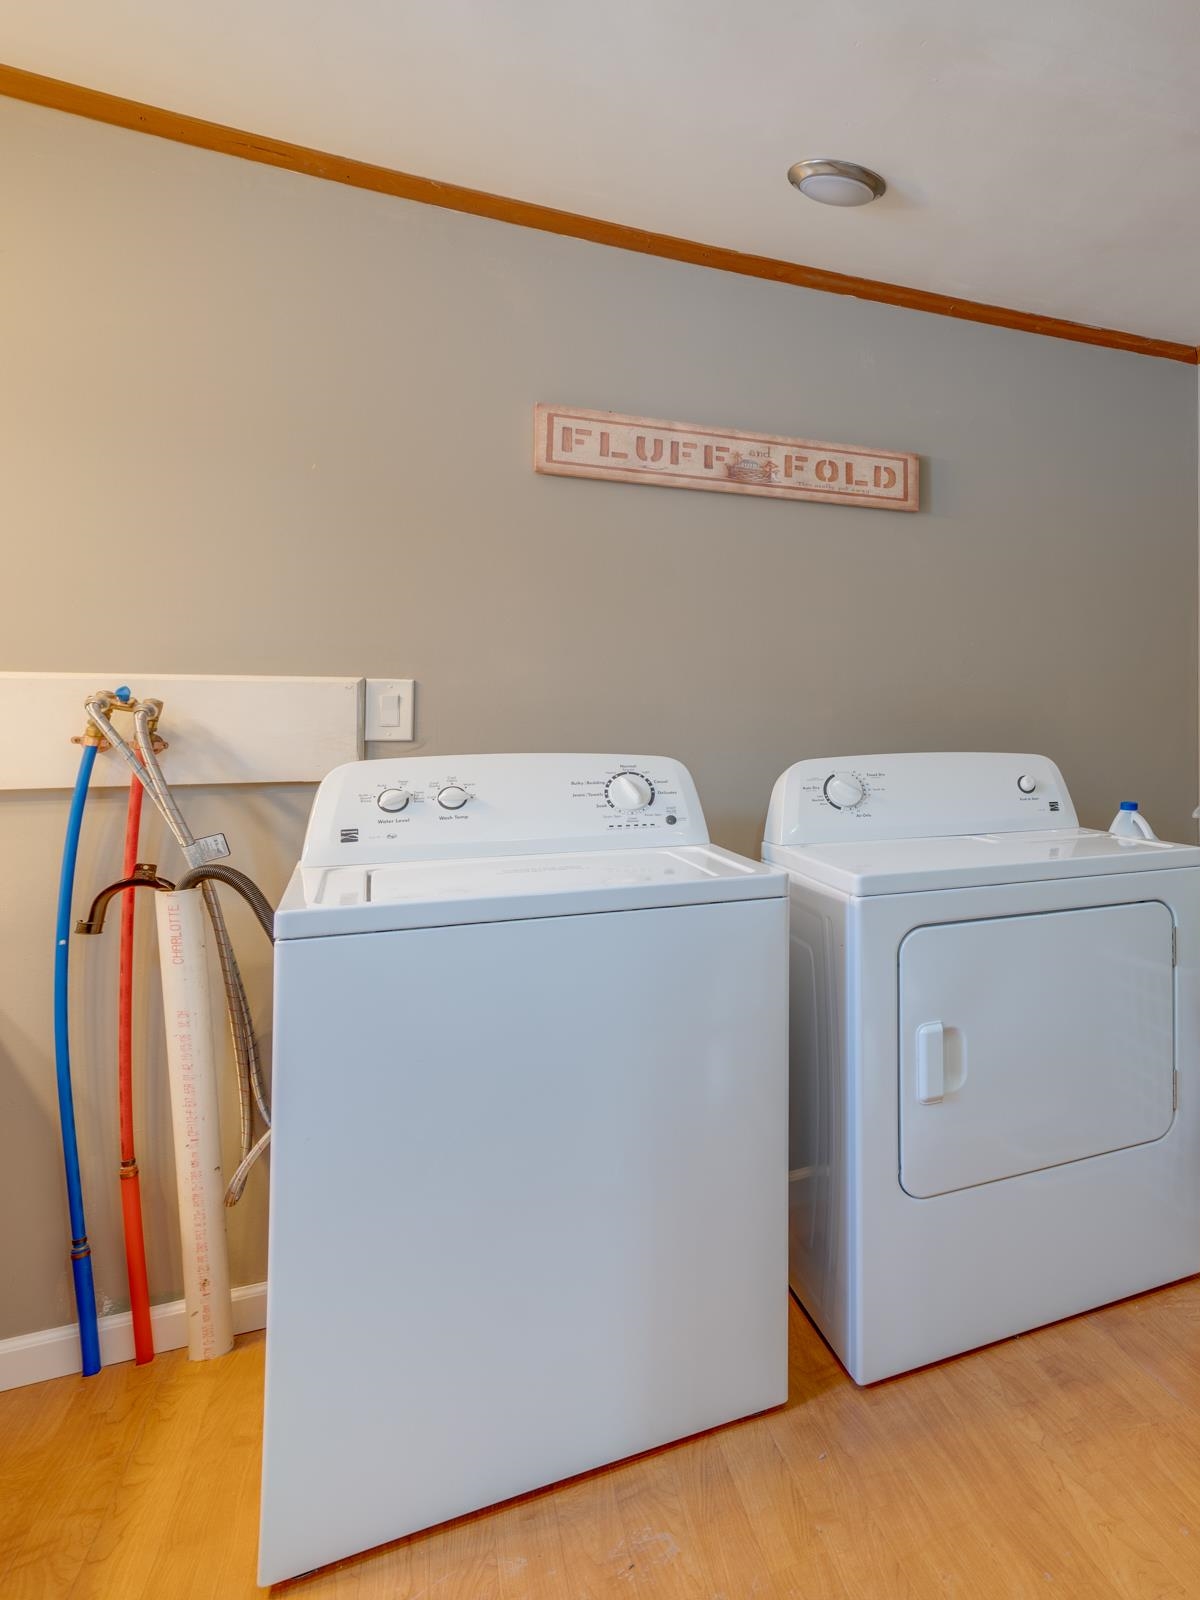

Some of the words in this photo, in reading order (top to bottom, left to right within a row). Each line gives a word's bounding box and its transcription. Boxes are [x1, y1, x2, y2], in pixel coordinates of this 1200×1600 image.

[561, 426, 730, 470] FLUFF
[748, 446, 771, 459] and
[783, 454, 897, 489] FOLD
[168, 903, 185, 965] CHARLOTTE
